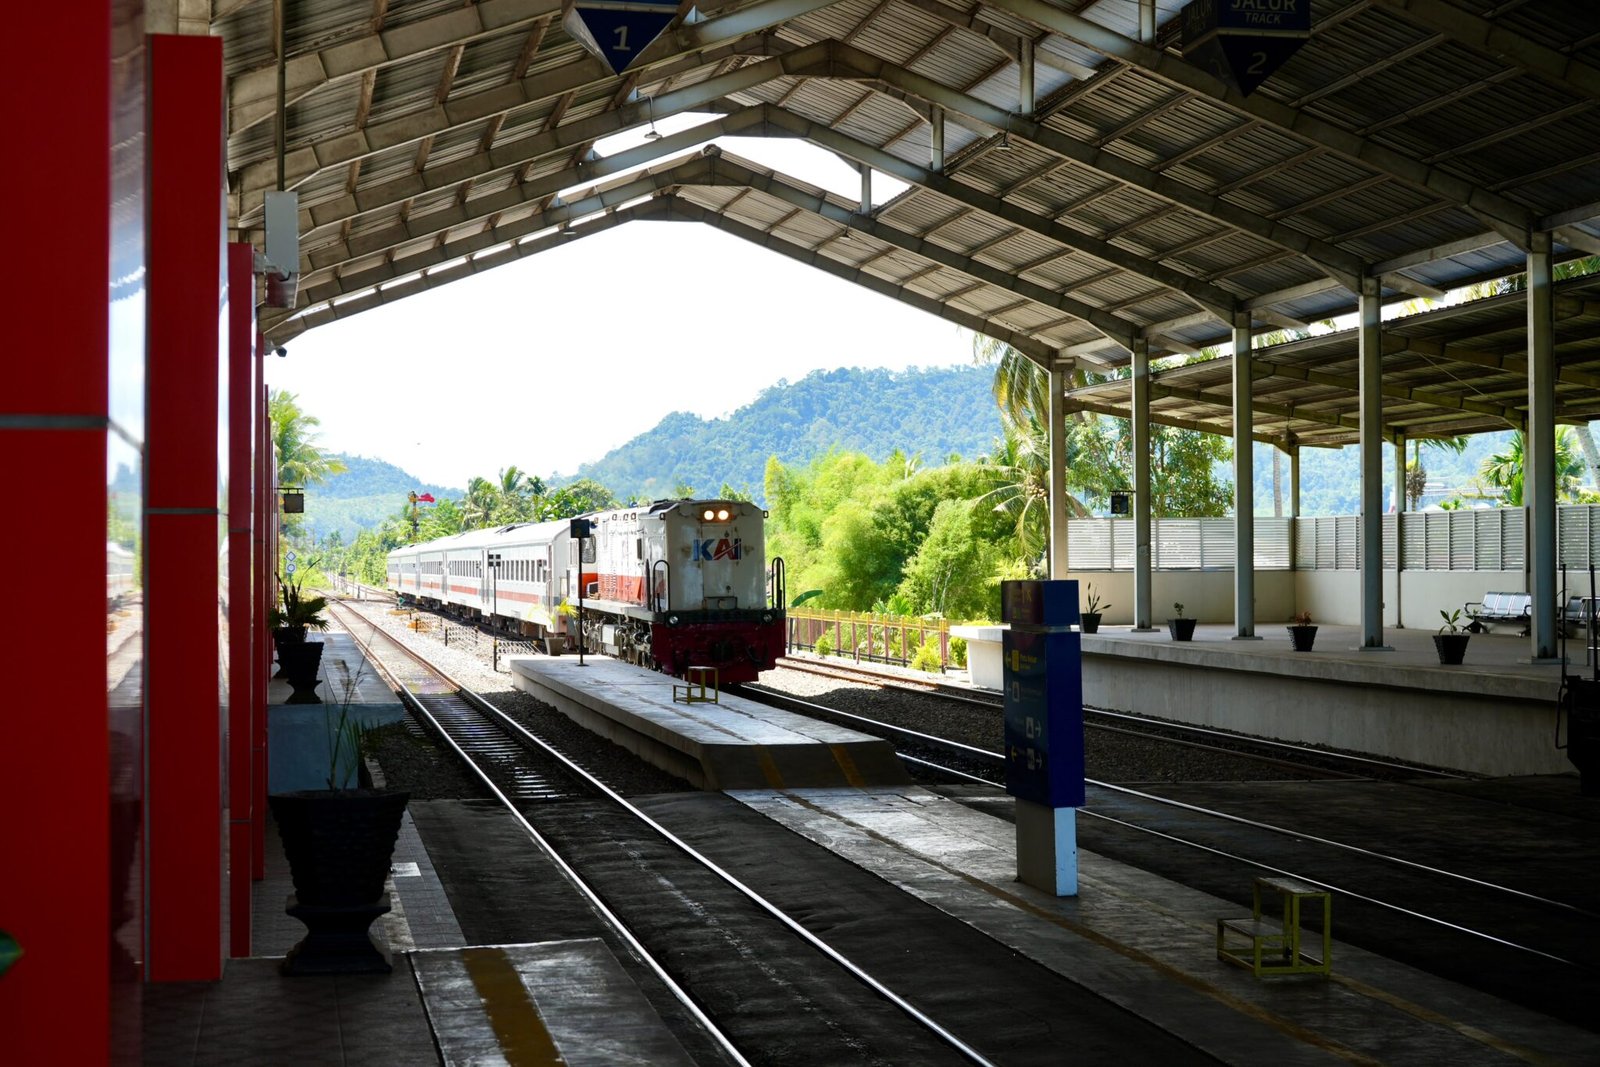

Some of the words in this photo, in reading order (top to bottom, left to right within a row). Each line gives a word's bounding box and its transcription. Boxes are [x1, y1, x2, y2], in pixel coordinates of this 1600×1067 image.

[1245, 12, 1281, 25] TRACK
[613, 26, 631, 50] 1
[1246, 50, 1269, 75] 2
[694, 538, 742, 560] KAI
